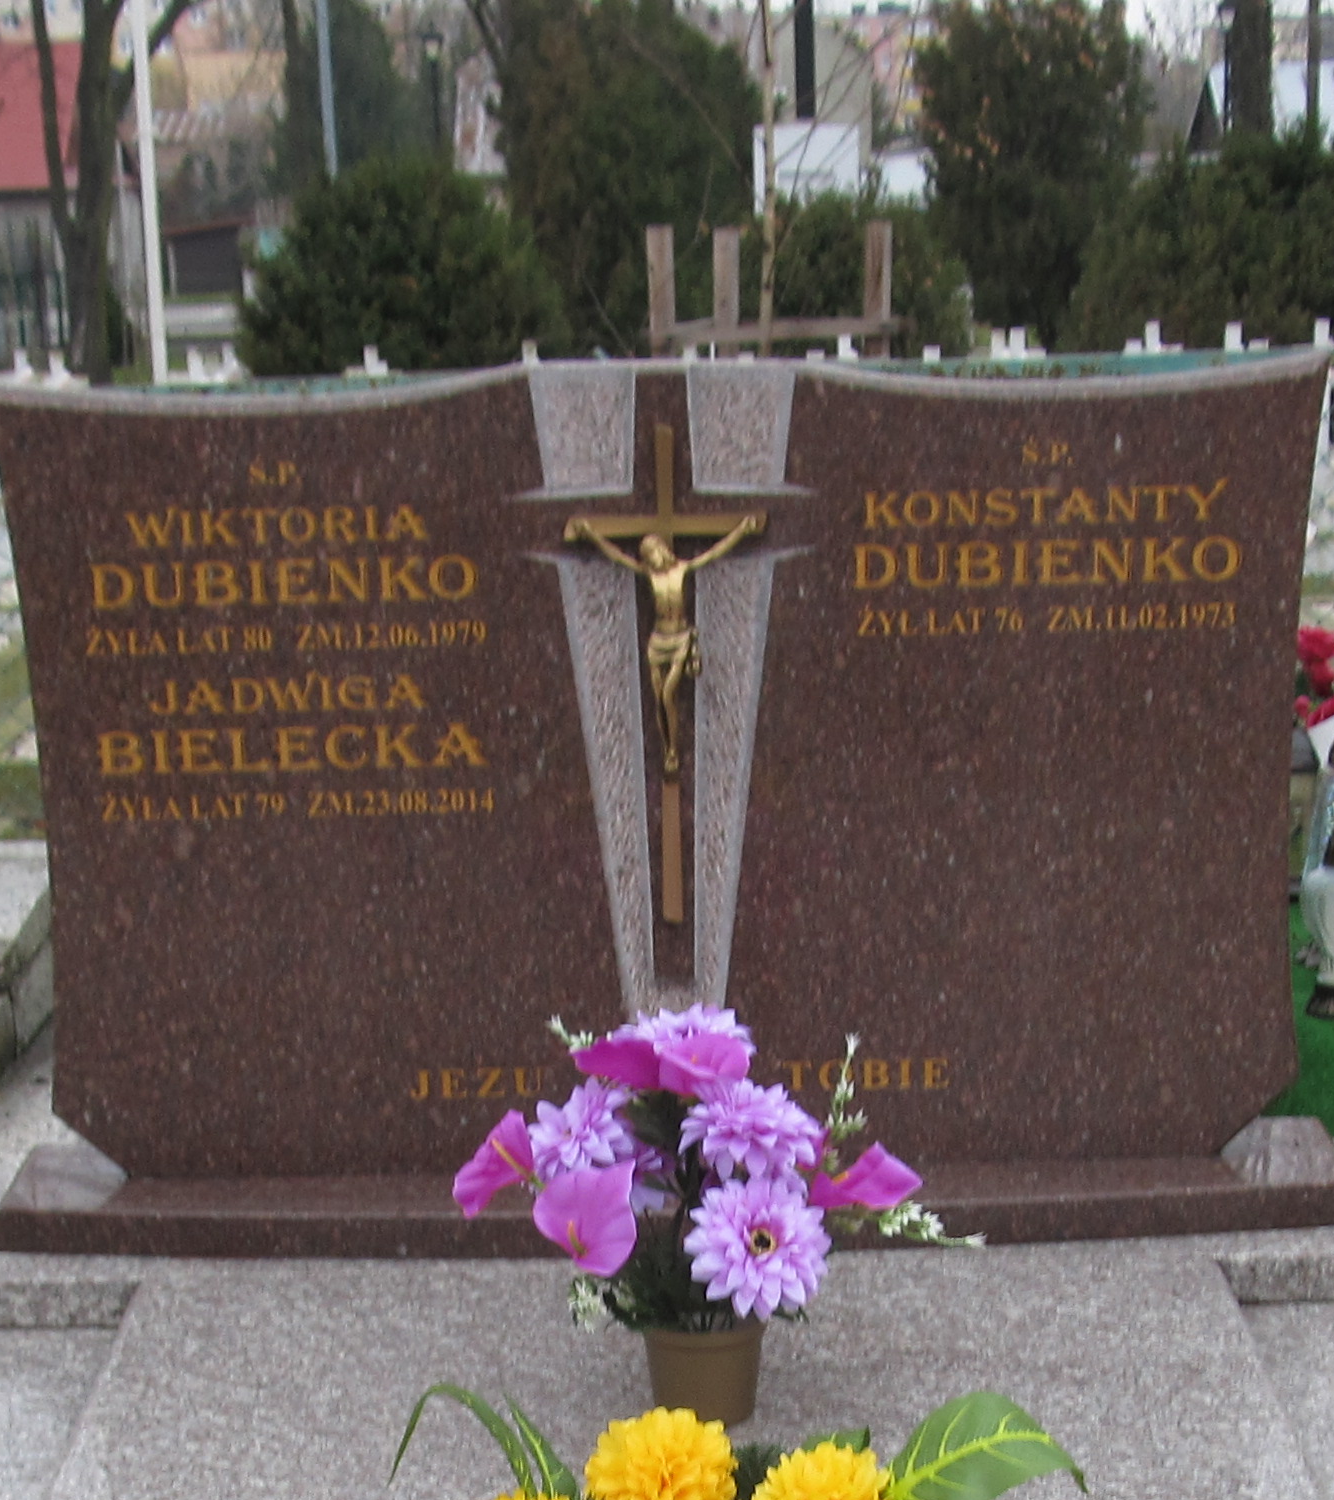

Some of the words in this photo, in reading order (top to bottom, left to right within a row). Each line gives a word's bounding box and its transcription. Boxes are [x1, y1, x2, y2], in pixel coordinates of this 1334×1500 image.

[864, 477, 1230, 530] KONSTANTY
[125, 504, 430, 549] WIKTORIA
[89, 554, 479, 610] DUBIENKO
[853, 534, 1243, 590] DUBIENKO
[176, 624, 234, 655] LAT
[927, 607, 986, 636] LAT
[994, 606, 1023, 633] 76
[149, 671, 427, 717] JADWIGA
[96, 722, 489, 777] BIELECKA
[190, 793, 247, 821] LAT
[410, 1066, 544, 1100] JEZU
[782, 1056, 950, 1093] TOBIE
